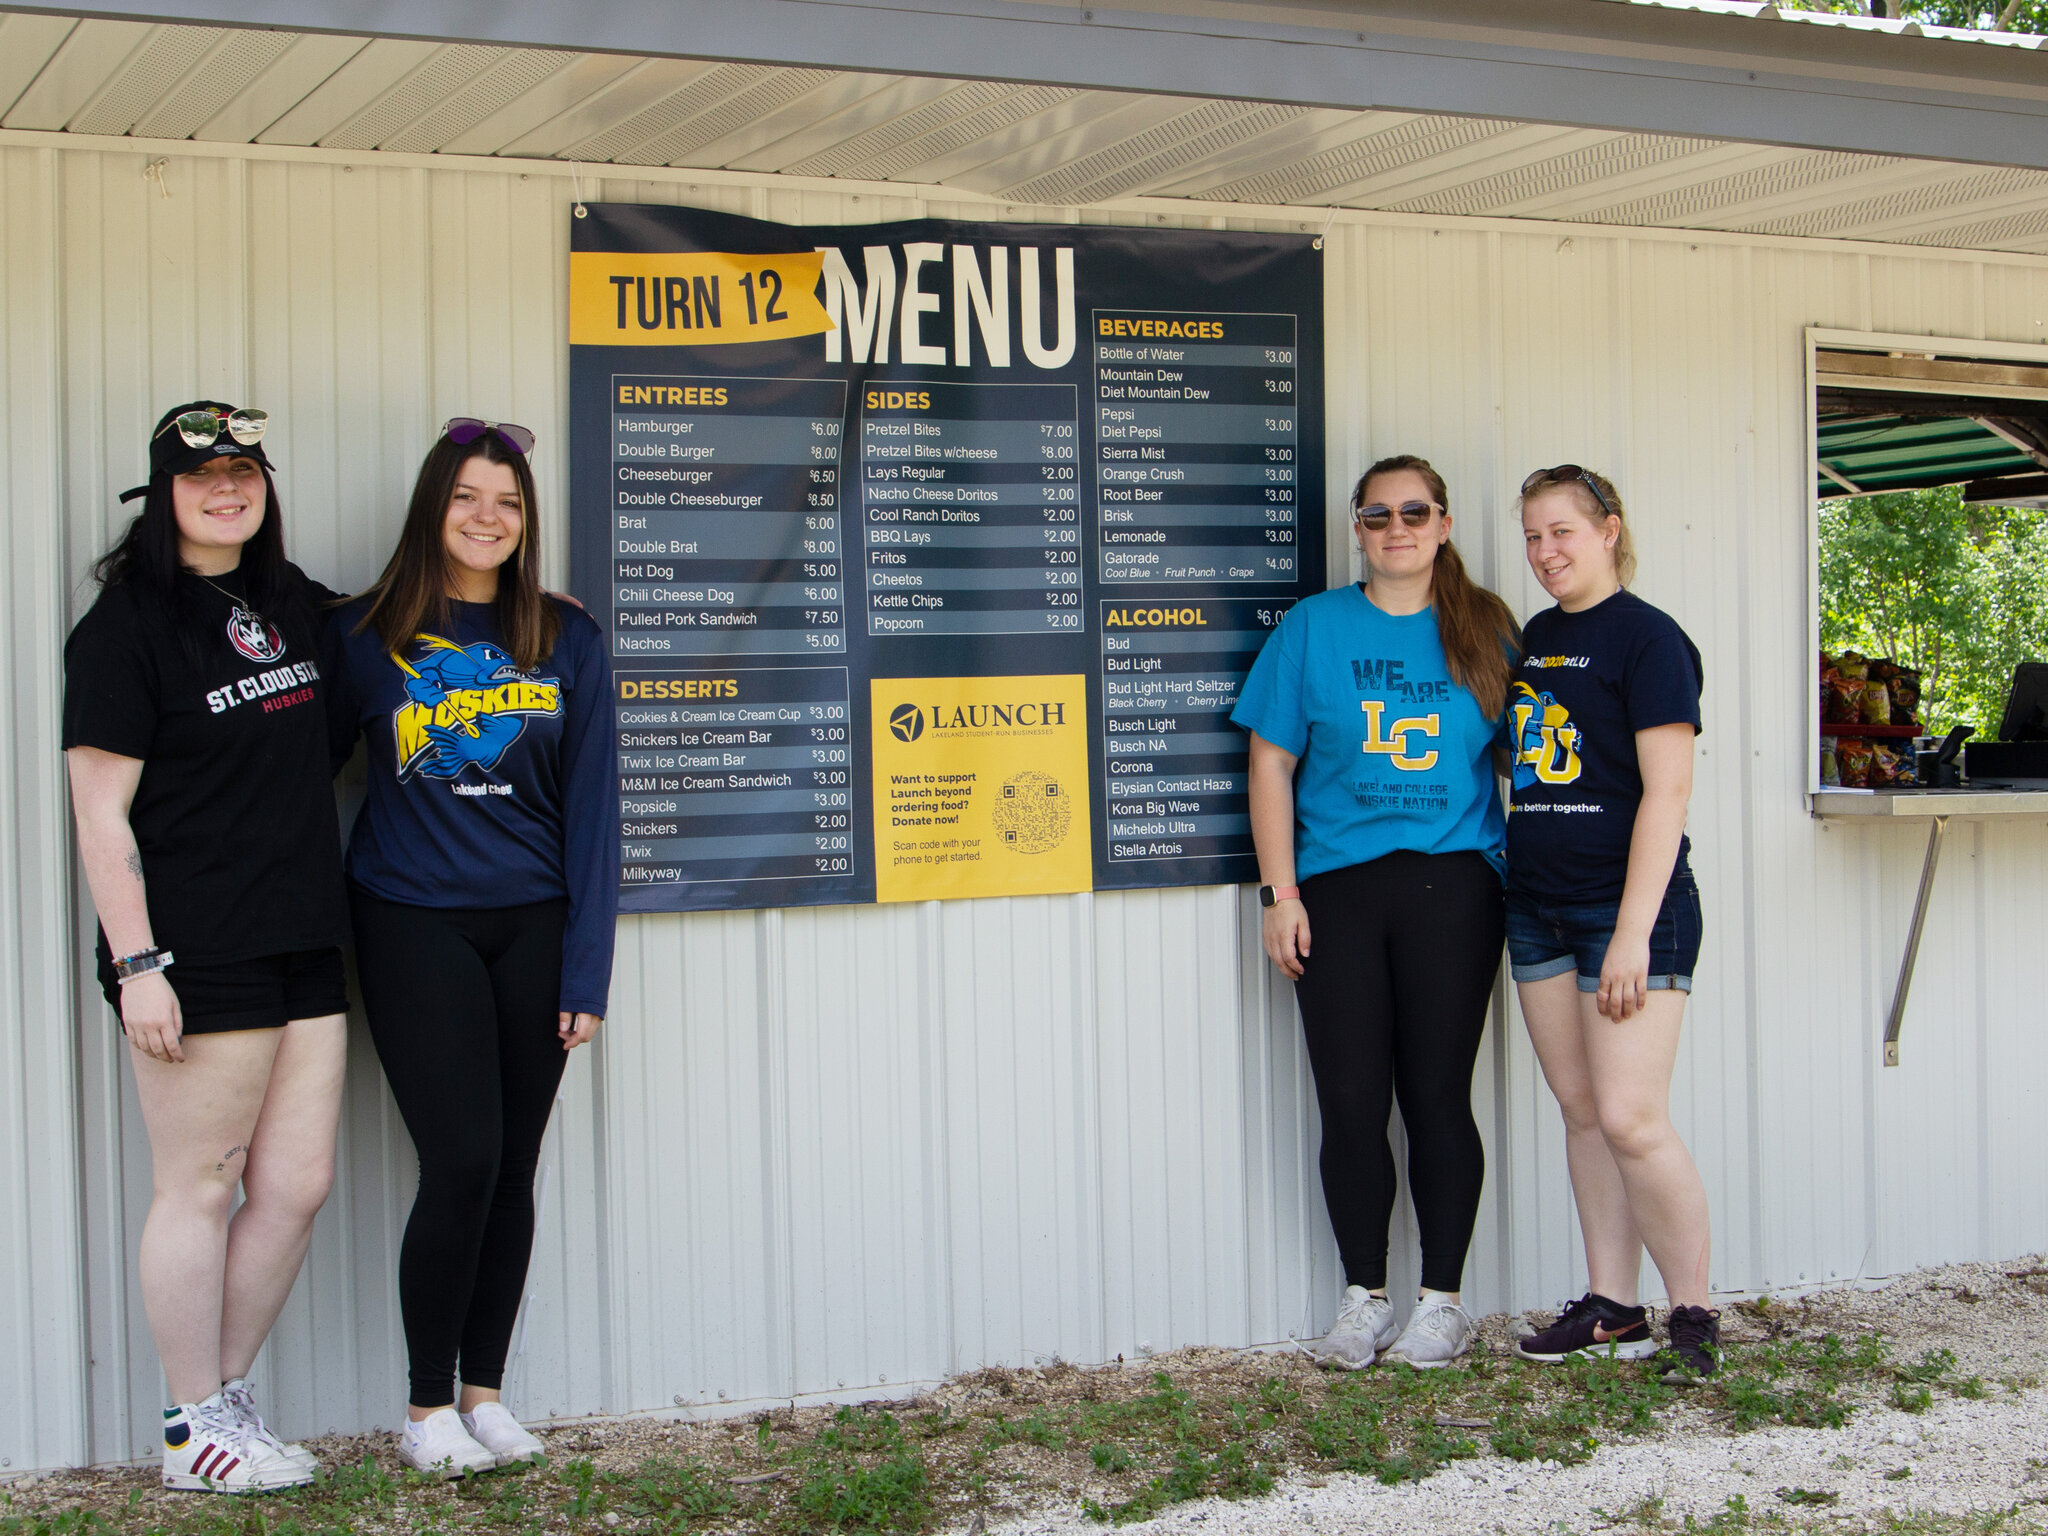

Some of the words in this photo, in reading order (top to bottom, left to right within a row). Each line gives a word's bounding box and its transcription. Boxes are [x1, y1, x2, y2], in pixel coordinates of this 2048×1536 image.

[609, 274, 721, 330] TURN
[738, 269, 788, 325] 12
[814, 242, 1076, 369] MENU
[1100, 319, 1224, 339] BEVERAGES
[1100, 347, 1133, 359] Bottle
[1137, 348, 1147, 359] of
[1151, 349, 1184, 360] Water
[1265, 350, 1291, 363] $3.00
[1101, 369, 1153, 381] Mountain
[1158, 370, 1183, 381] Dew
[619, 386, 728, 406] ENTREES
[866, 392, 931, 410] SIDES
[1102, 408, 1135, 423] Pepsi
[619, 419, 693, 435] Hamburger
[812, 423, 839, 436] $6.00
[867, 445, 911, 457] Pretzel
[915, 445, 941, 457] Bites
[944, 446, 997, 458] w/cheese
[1041, 446, 1073, 459] $8.00
[619, 468, 713, 484] Cheeseburger
[810, 470, 834, 483] $6.50
[868, 466, 898, 480] Lays
[902, 467, 945, 481] Regular
[1042, 467, 1073, 479] $2.00
[1103, 468, 1147, 482] Orange
[1151, 468, 1184, 480] Crush
[1265, 469, 1292, 481] $3.00
[619, 492, 666, 505] Double
[670, 493, 762, 508] Cheeseburger
[808, 494, 834, 506] $8.50
[869, 487, 909, 499] Nacho
[913, 488, 953, 500] Cheese
[957, 489, 998, 501] Doritos
[1043, 488, 1074, 500] $2.00
[619, 516, 646, 529] Brat
[806, 517, 834, 529] $6.00
[1105, 531, 1166, 542] Lemonade
[1266, 530, 1292, 542] $3.00
[872, 552, 906, 564] Fritos
[1045, 551, 1076, 563] $2.00
[1105, 552, 1159, 564] Gatorade
[1266, 558, 1292, 570] $4.00
[619, 565, 643, 577] Hot
[647, 565, 674, 580] Dog
[804, 564, 836, 577] $5.00
[1105, 569, 1127, 578] Cool
[1130, 569, 1150, 577] Blue
[1165, 568, 1186, 577] Fruit
[1188, 568, 1215, 577] Punch
[1229, 568, 1254, 579] Grape
[619, 589, 648, 601] Chili
[653, 589, 703, 601] Cheese
[708, 589, 734, 604] Dog
[804, 588, 837, 600] $6.00
[874, 594, 908, 607] Kettle
[912, 594, 943, 609] Chips
[1046, 593, 1077, 605] $2.00
[620, 613, 661, 625] Pulled
[665, 613, 696, 625] Pork
[700, 613, 757, 624] Sandwich
[805, 611, 838, 623] $7.50
[1106, 608, 1207, 626] ALCOHOL
[620, 637, 671, 650] Nachos
[806, 635, 839, 647] $5.00
[1108, 638, 1129, 649] Bud
[1351, 659, 1404, 690] WE
[207, 685, 241, 713] ST.
[237, 667, 298, 700] CLOUD
[621, 679, 738, 699] DESSERTS
[1109, 682, 1131, 694] Bud
[1135, 682, 1162, 696] Light
[1166, 681, 1192, 692] Hard
[1196, 680, 1235, 691] Seltzer
[1400, 681, 1450, 703] ARE
[262, 688, 314, 713] HUSKIES
[1109, 699, 1134, 708] Black
[1137, 698, 1167, 709] Cherry
[1187, 696, 1219, 708] Cherry
[621, 712, 667, 723] Cookies
[670, 712, 678, 722] &
[682, 711, 716, 722] Cream
[719, 710, 735, 721] Ice
[738, 709, 776, 720] Cream
[778, 708, 801, 721] Cup
[810, 707, 843, 719] $3.00
[932, 703, 1066, 729] LAUNCH
[397, 682, 558, 767] MUSKIES
[1110, 720, 1144, 732] Busch
[1148, 719, 1176, 733] Light
[621, 733, 677, 746] Snickers
[681, 733, 699, 745] Ice
[703, 732, 745, 744] Cream
[749, 731, 772, 743] Bar
[811, 728, 844, 741] $3.00
[1361, 700, 1440, 771] LC
[1514, 704, 1581, 784] LU
[1111, 762, 1153, 773] Corona
[622, 778, 656, 791] M&M
[661, 777, 679, 790] Ice
[683, 776, 724, 789] Cream
[729, 774, 791, 788] Sandwich
[814, 771, 846, 784] $3.00
[891, 775, 921, 784] Want
[924, 775, 935, 783] to
[938, 773, 976, 784] support
[891, 789, 932, 798] Launch
[935, 786, 971, 798] beyond
[1112, 782, 1153, 797] Elysian
[1157, 780, 1200, 792] Contact
[1204, 779, 1232, 790] Haze
[1353, 782, 1402, 794] LAKELAND
[1405, 784, 1448, 795] COLLEGE
[622, 800, 677, 816] Popsicle
[815, 793, 846, 806] $3.00
[892, 803, 938, 813] ordering
[941, 801, 969, 810] food?
[1113, 803, 1142, 815] Kona
[1147, 802, 1165, 816] Big
[1168, 801, 1199, 812] Wave
[1354, 794, 1399, 808] MUSKIE
[1403, 798, 1448, 810] NATION
[1524, 803, 1551, 812] better
[1554, 803, 1603, 814] together.
[893, 817, 932, 826] Donate
[935, 815, 959, 824] now!
[1113, 823, 1165, 836] Michelob
[1169, 822, 1195, 833] Ultra
[893, 841, 916, 851] Scan
[920, 840, 940, 849] code
[943, 840, 959, 848] with
[962, 840, 981, 850] your
[1114, 844, 1146, 856] Stella
[1149, 843, 1182, 855] Artois
[894, 855, 922, 866] phone
[924, 854, 932, 863] to
[935, 854, 948, 865] get
[951, 852, 982, 862] started.
[623, 867, 681, 882] Milkyway
[816, 859, 847, 871] $2.00
